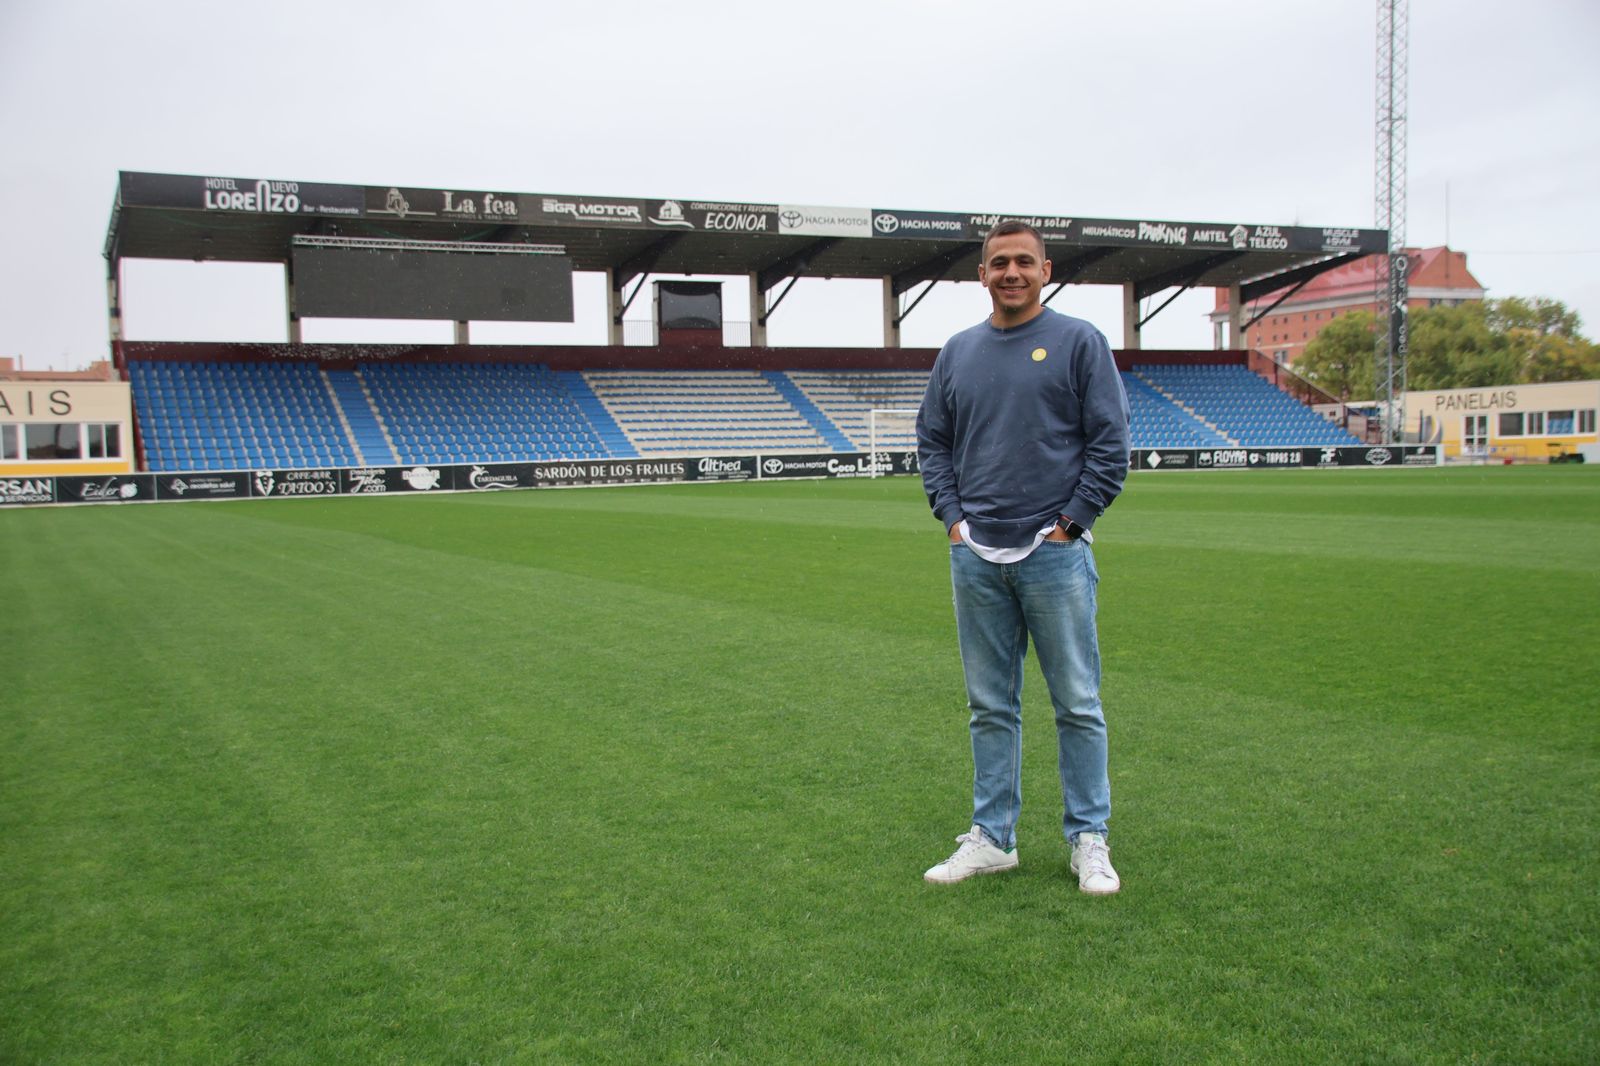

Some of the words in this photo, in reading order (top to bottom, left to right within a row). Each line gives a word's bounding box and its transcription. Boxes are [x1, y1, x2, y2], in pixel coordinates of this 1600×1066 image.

[205, 178, 238, 190] HOTEL
[442, 191, 477, 214] La
[483, 193, 518, 216] fea
[579, 203, 643, 221] MOTOR
[704, 212, 767, 231] ECONOA
[805, 216, 834, 225] HACHA
[837, 217, 869, 227] MOTOR
[901, 219, 929, 230] HACHA
[932, 221, 962, 231] MOTOR
[1044, 218, 1072, 228] solar
[1193, 230, 1228, 243] AMTEL
[1255, 226, 1281, 238] AZUL
[1249, 237, 1288, 250] TELECO
[1435, 391, 1517, 411] PANELAIS
[1266, 452, 1288, 464] TAPAS
[533, 464, 586, 480] SARDÓN
[591, 464, 606, 477] DE
[611, 464, 633, 476] LOS
[637, 462, 685, 475] FRAILES
[785, 462, 805, 470] HACHA
[806, 461, 826, 469] MOTOR
[827, 458, 856, 473] Coco
